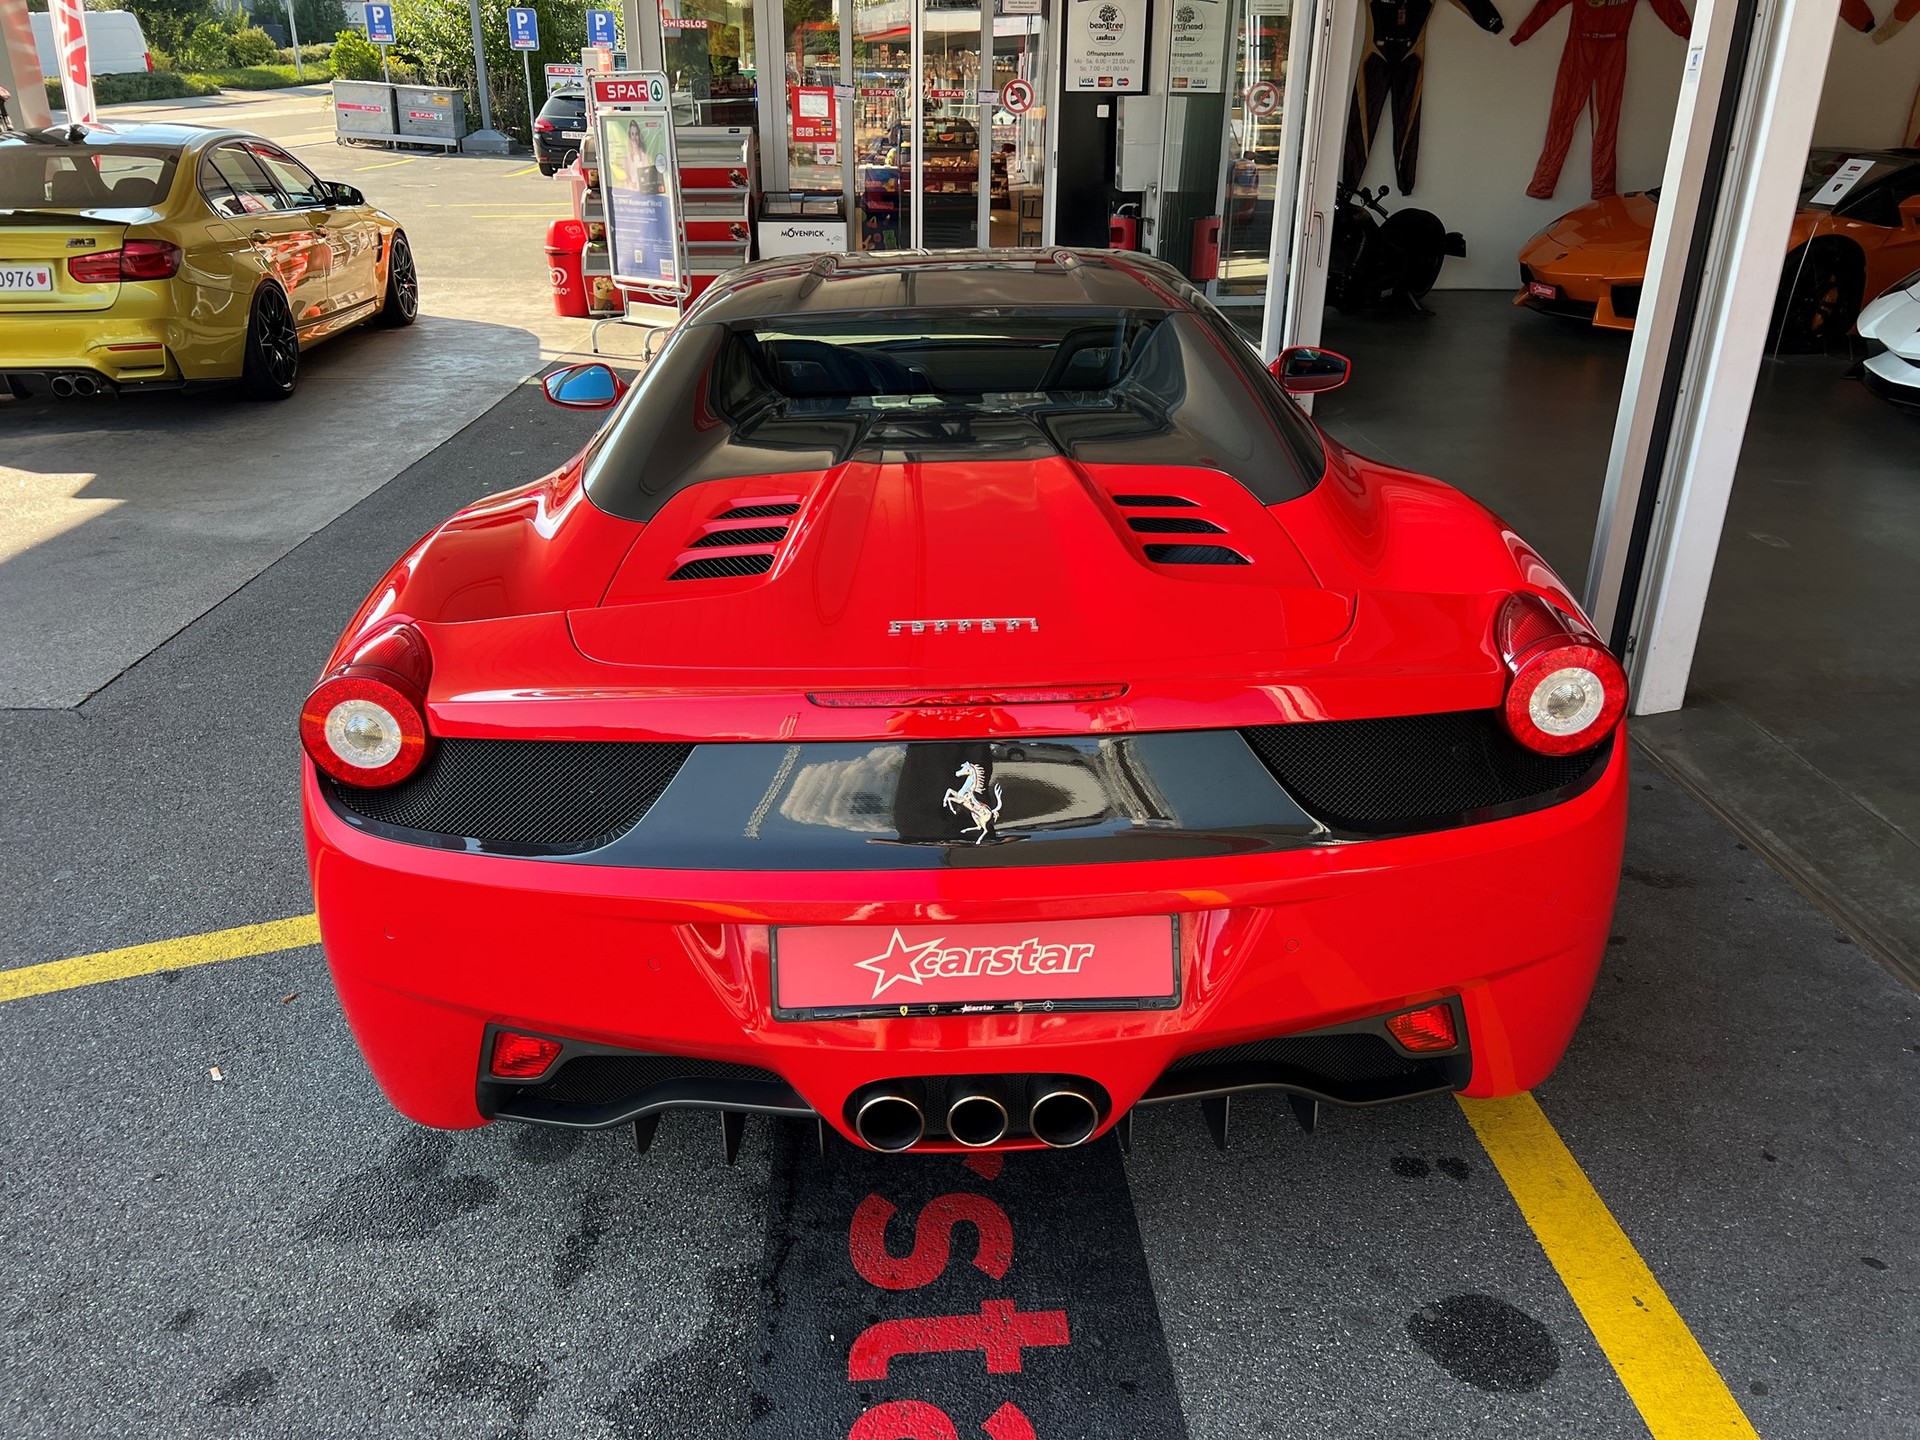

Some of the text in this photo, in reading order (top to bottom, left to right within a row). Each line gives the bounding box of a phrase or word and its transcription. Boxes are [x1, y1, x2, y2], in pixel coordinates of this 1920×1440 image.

[372, 7, 384, 24] P
[516, 12, 528, 29] P
[595, 14, 607, 31] P
[663, 20, 708, 29] SWISSLOS
[607, 84, 648, 99] SPAR
[67, 238, 96, 248] M3
[916, 937, 1096, 978] carstar
